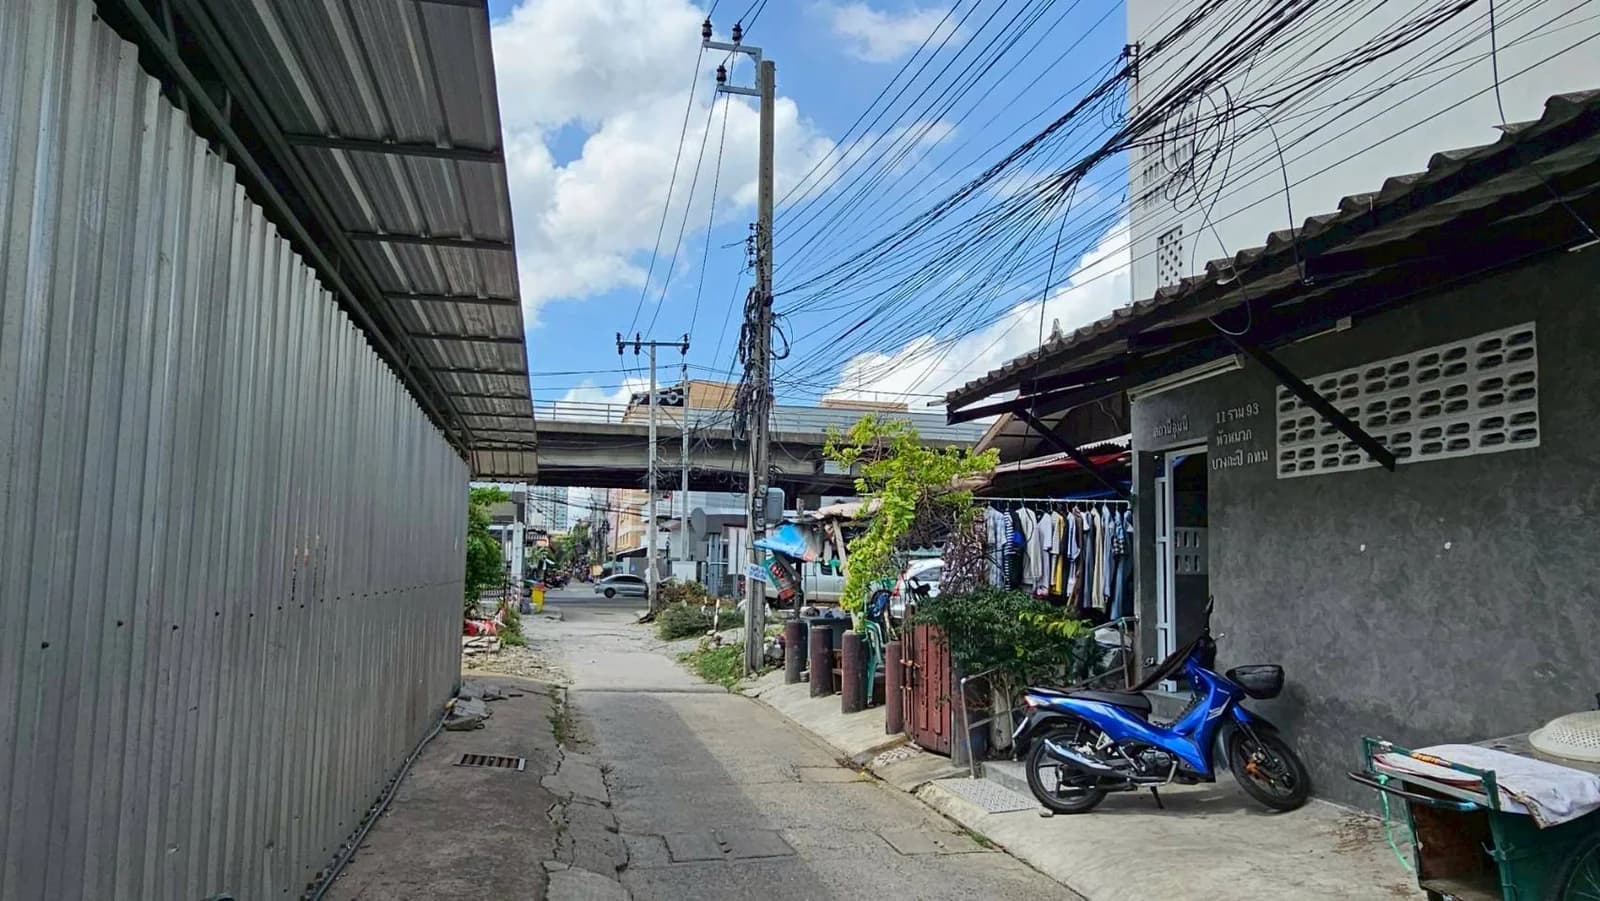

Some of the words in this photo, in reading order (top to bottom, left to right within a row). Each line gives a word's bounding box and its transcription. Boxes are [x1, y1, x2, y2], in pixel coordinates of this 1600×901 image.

[1227, 407, 1245, 421] ราม
[1246, 402, 1261, 417] 93
[1216, 429, 1252, 447] หัวหมาก
